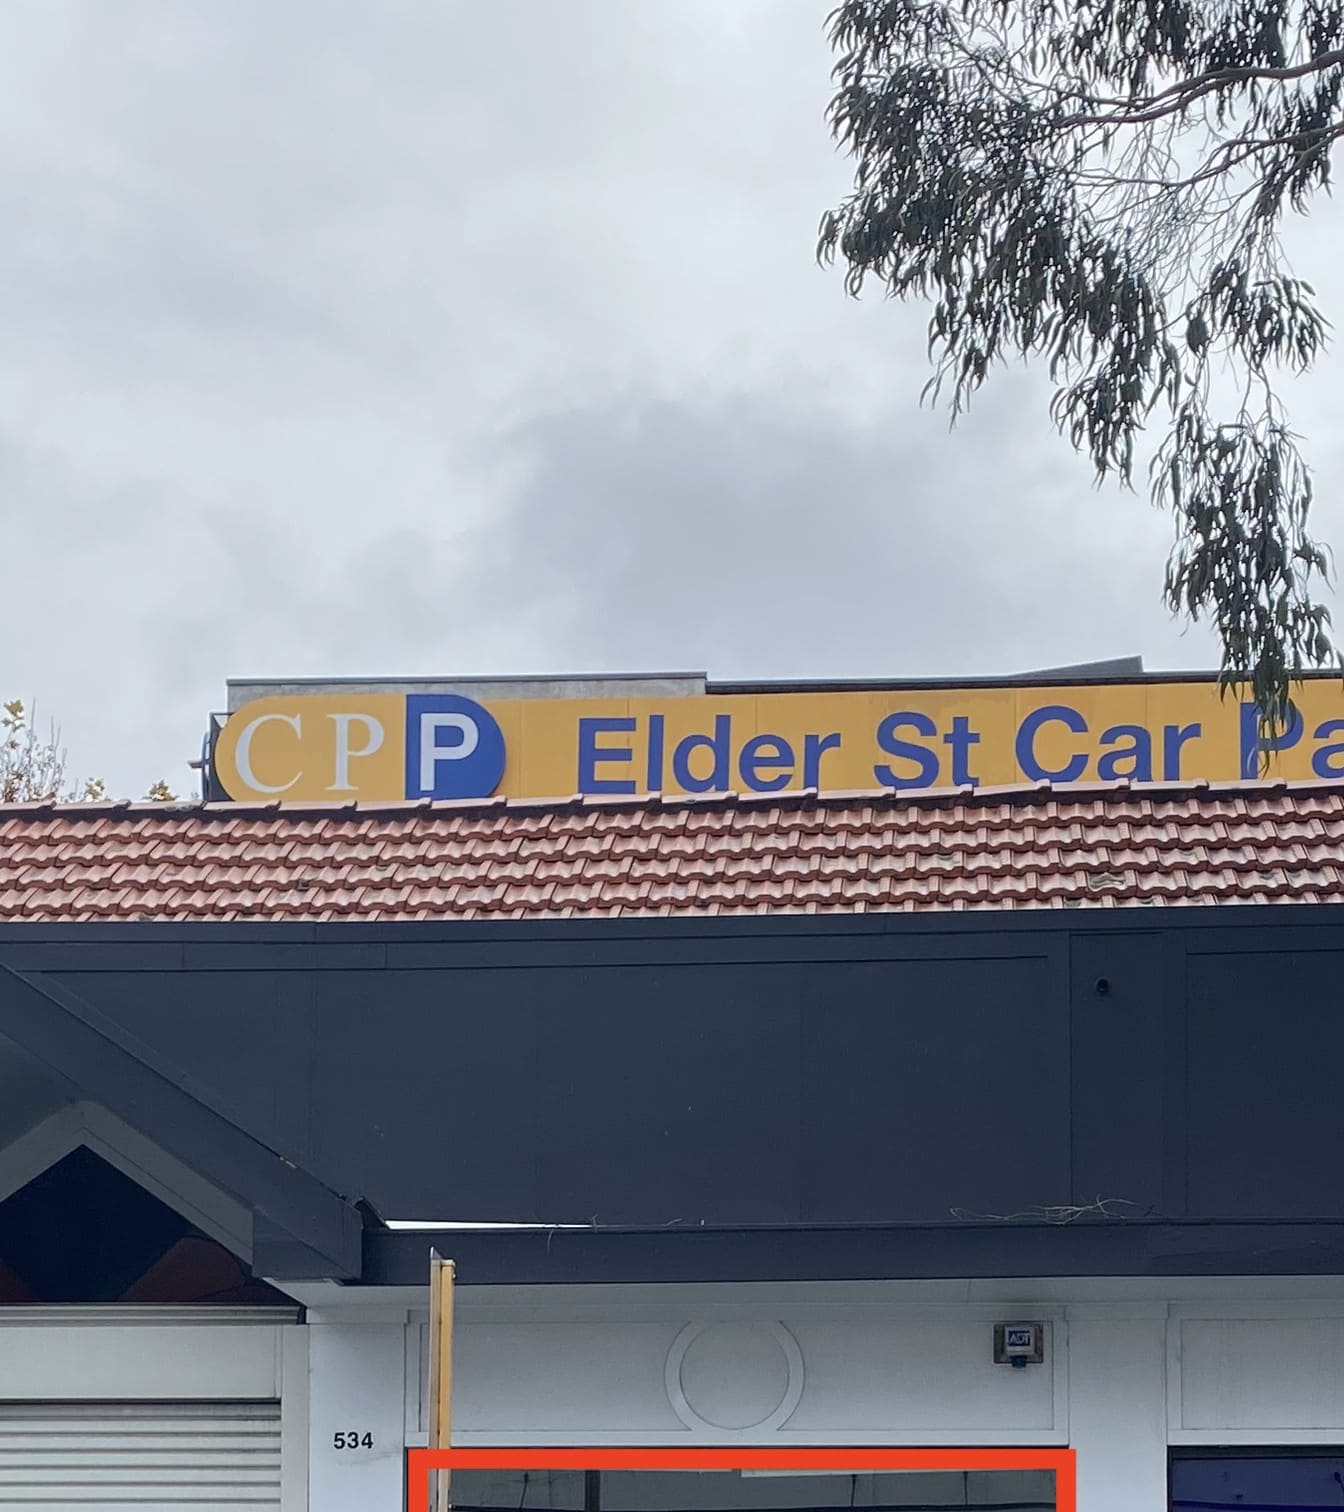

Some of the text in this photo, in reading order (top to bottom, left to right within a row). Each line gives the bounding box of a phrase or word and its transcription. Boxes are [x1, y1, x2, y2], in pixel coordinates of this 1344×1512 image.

[578, 714, 840, 794] Elder
[873, 711, 982, 790] St
[1015, 704, 1201, 784] Car
[1010, 1332, 1030, 1345] ADT
[333, 1432, 374, 1449] 534
